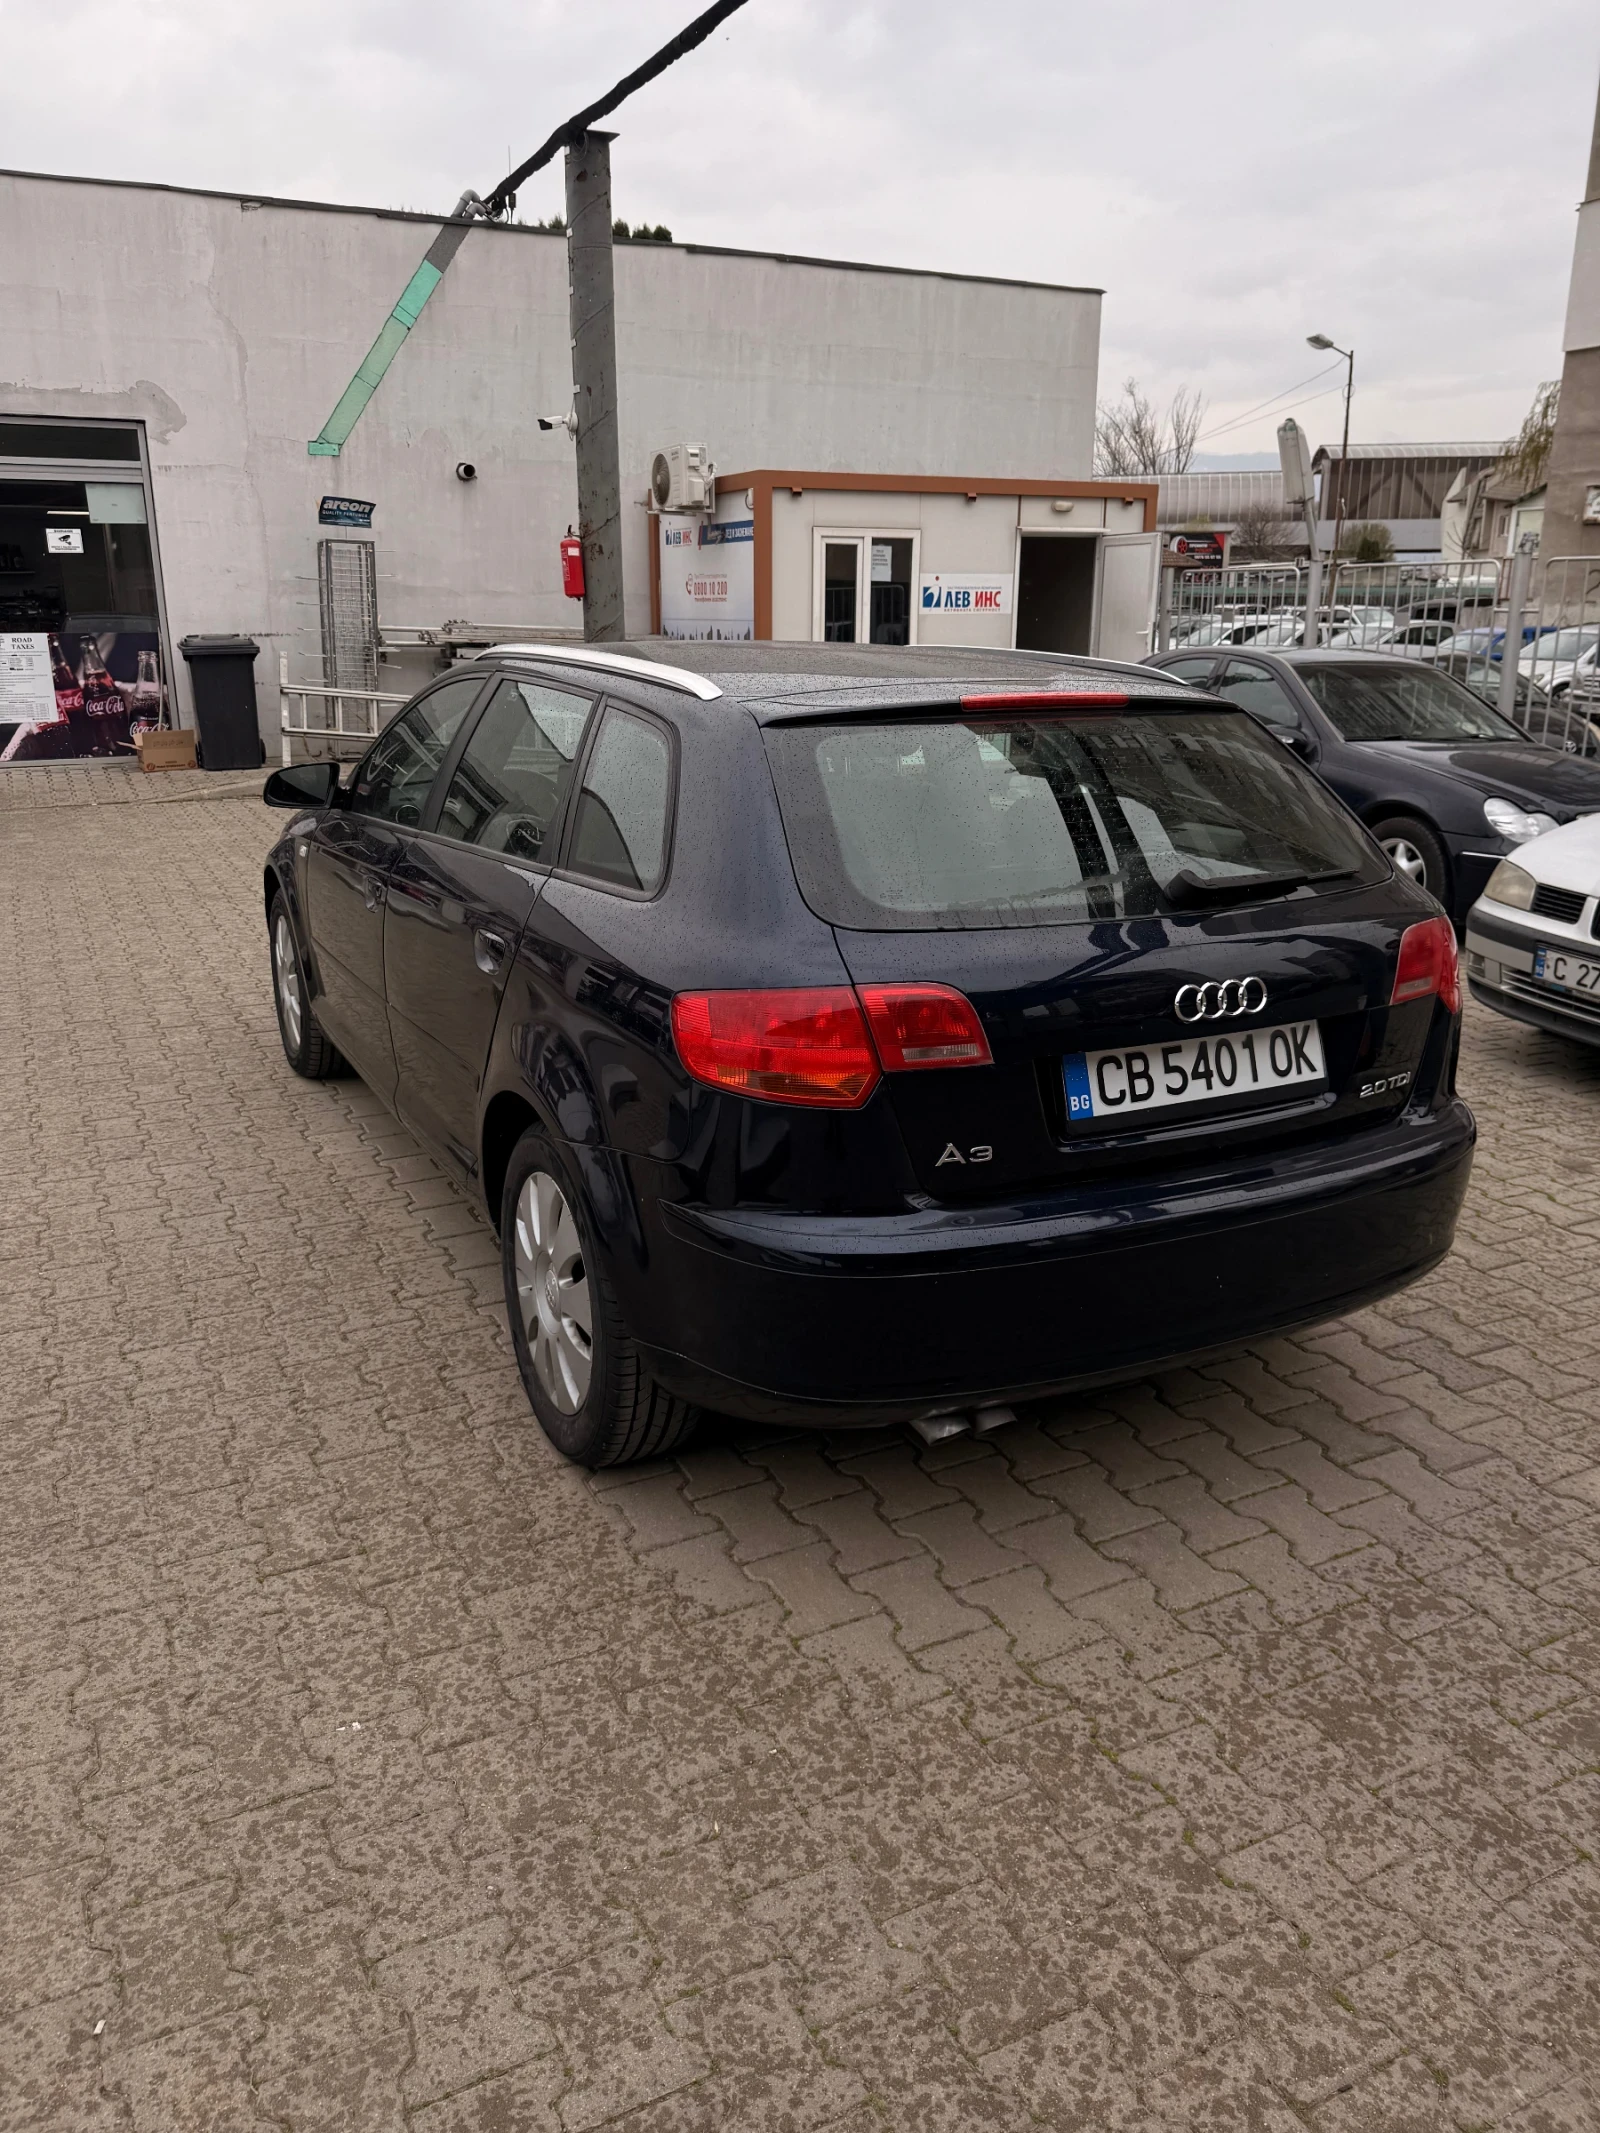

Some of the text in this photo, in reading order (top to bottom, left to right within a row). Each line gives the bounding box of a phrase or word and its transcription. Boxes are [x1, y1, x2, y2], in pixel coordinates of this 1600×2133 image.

[323, 500, 371, 513] areon
[709, 581, 716, 595] 10
[944, 590, 1002, 608] ЛЕВ ИНС
[86, 695, 125, 717] Coca-Cola
[1553, 957, 1567, 981] C
[1097, 1025, 1317, 1106] CB 5401 OK
[1388, 1071, 1411, 1089] TDI
[1070, 1094, 1090, 1112] BG
[935, 1142, 993, 1167] A3
